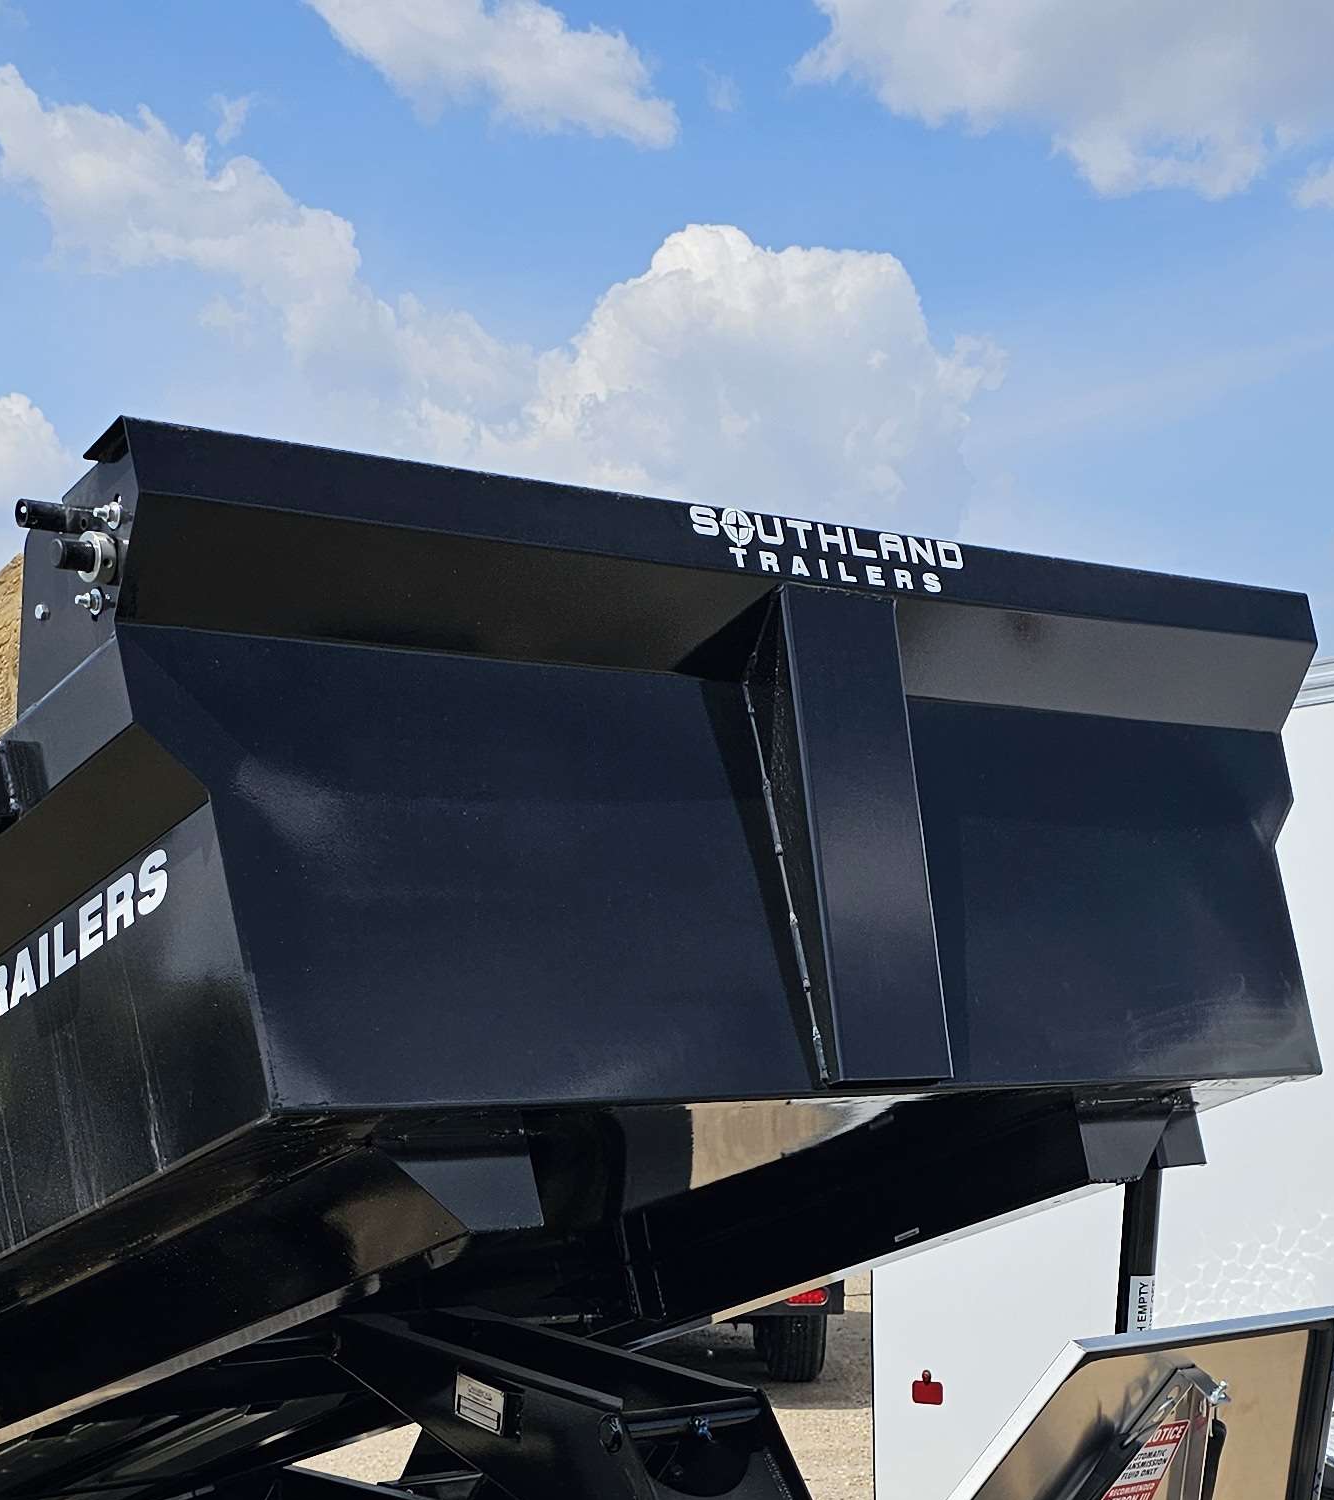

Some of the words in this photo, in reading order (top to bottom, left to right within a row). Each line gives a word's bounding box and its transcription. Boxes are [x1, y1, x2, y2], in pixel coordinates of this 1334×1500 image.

[689, 505, 964, 570] SOUTHLAND
[728, 546, 942, 593] TRAILERS
[1137, 1281, 1149, 1323] EMPTY
